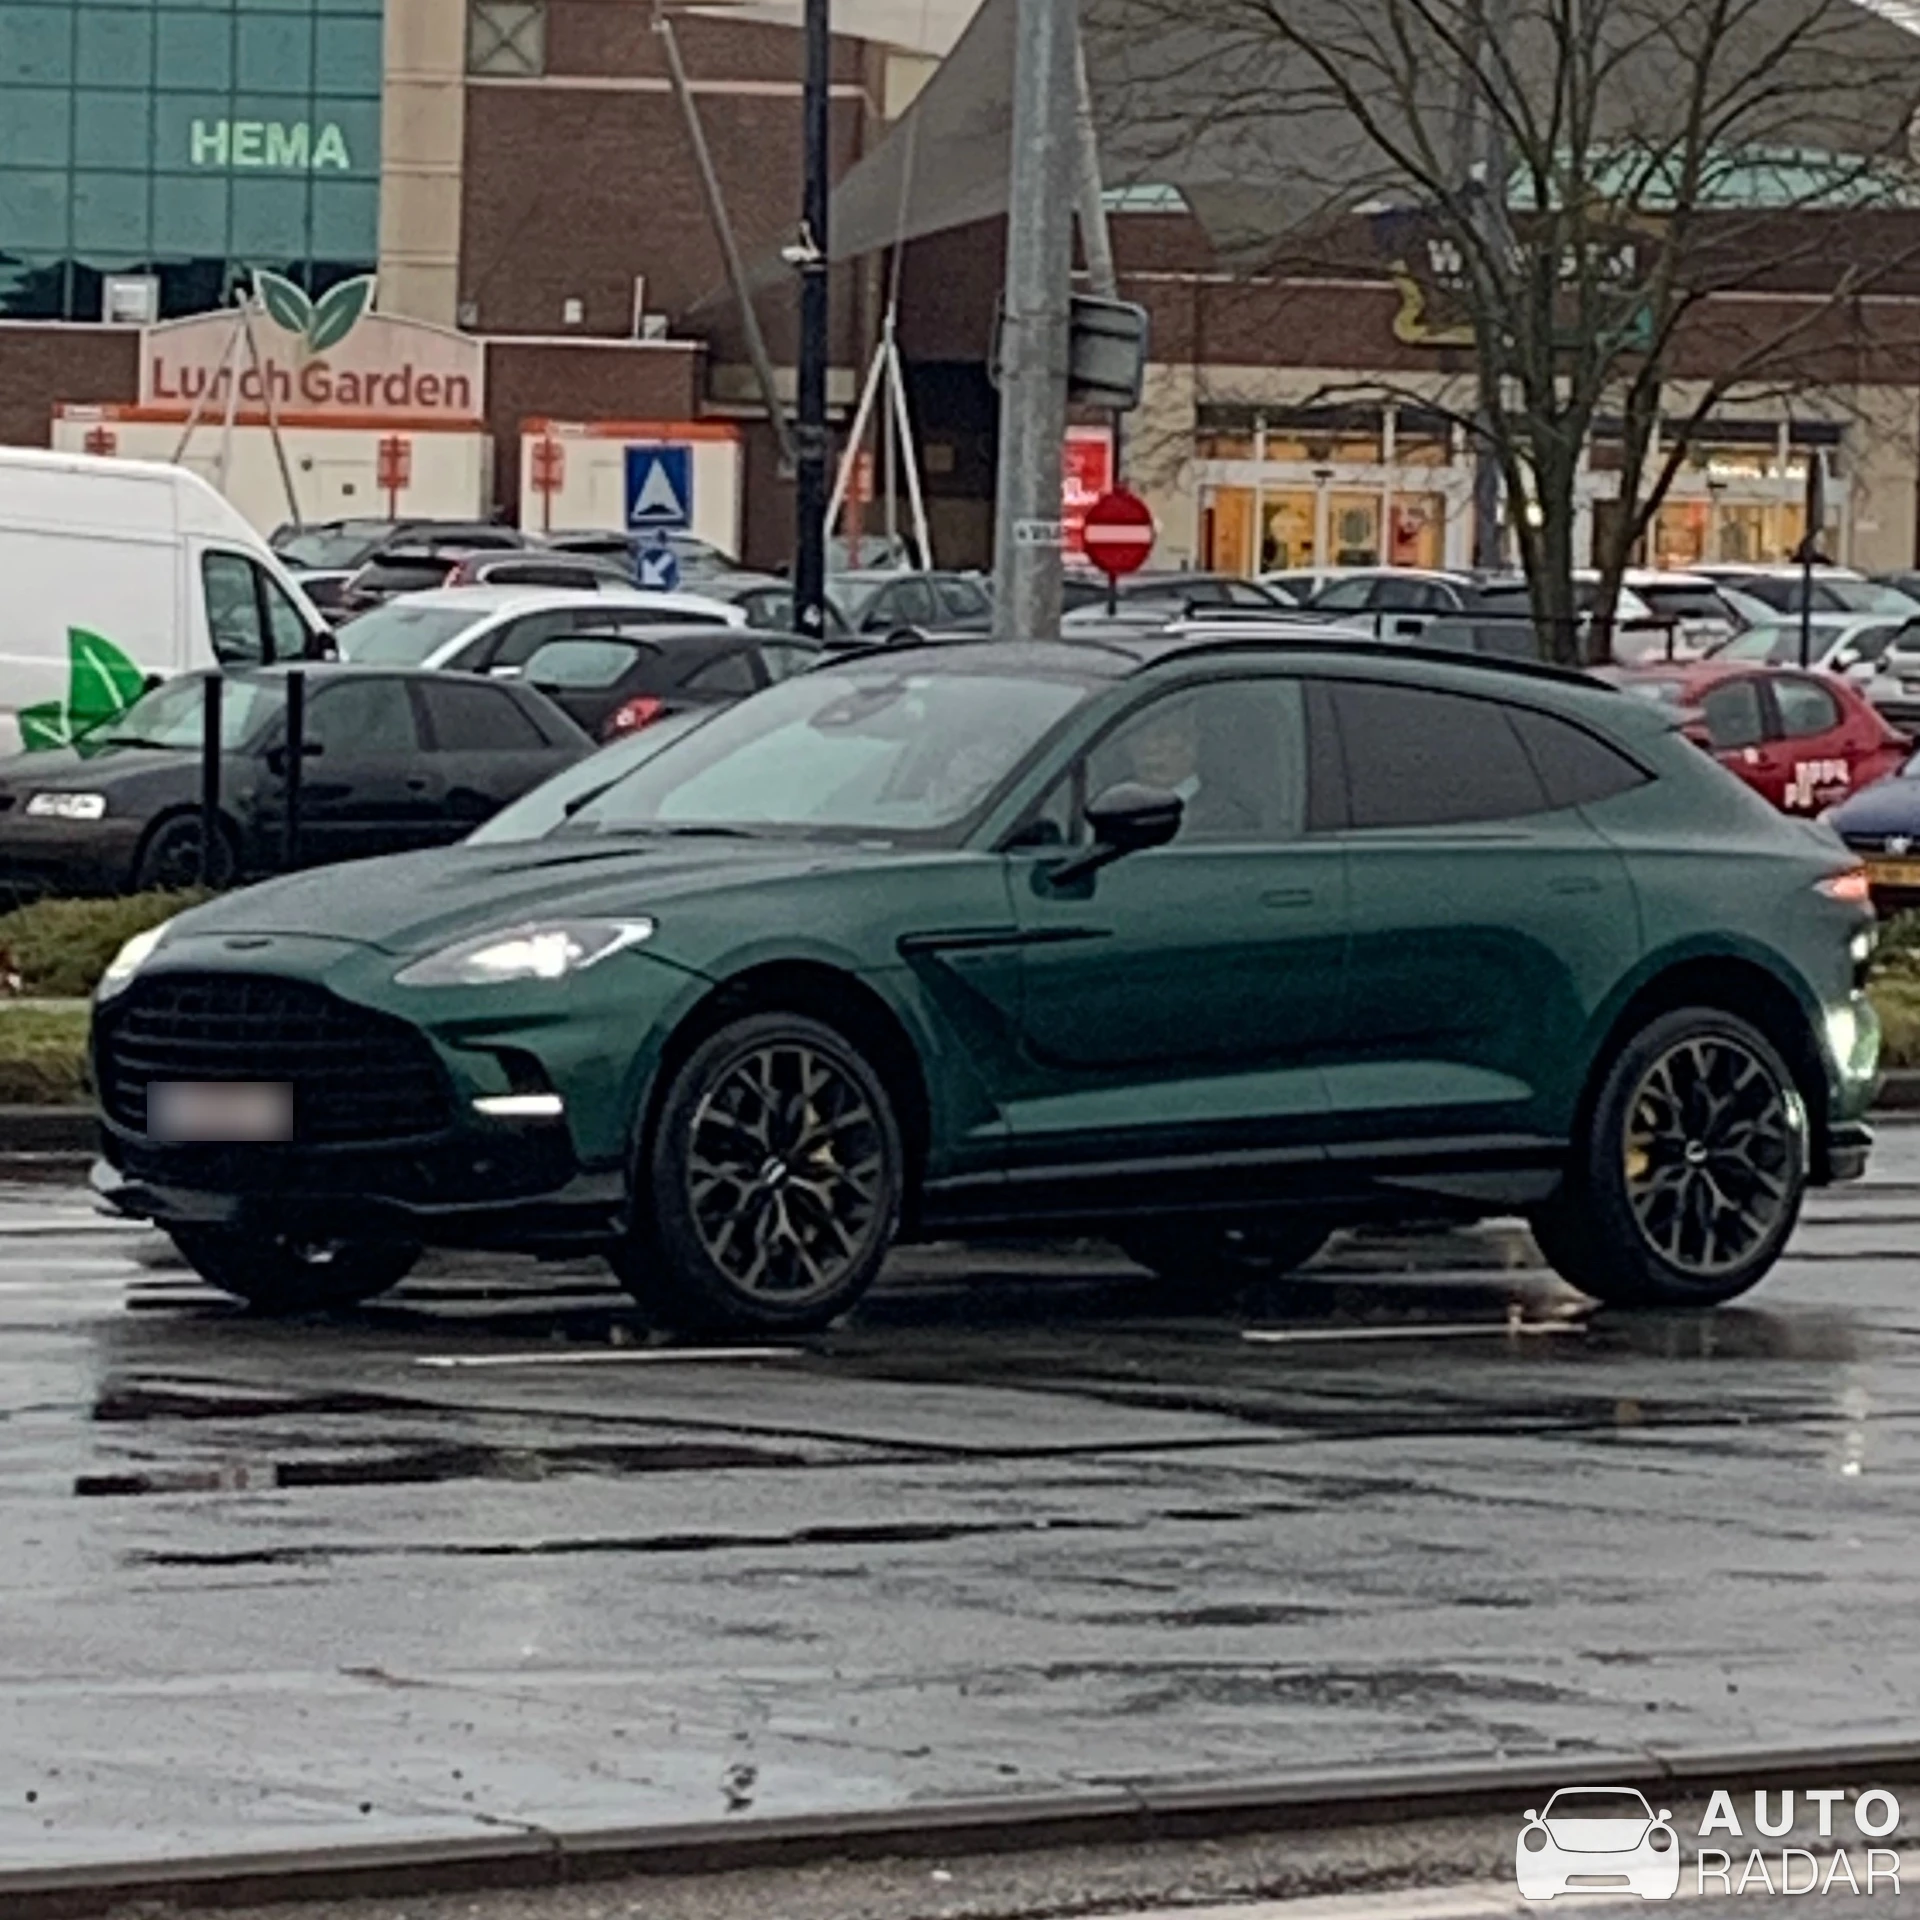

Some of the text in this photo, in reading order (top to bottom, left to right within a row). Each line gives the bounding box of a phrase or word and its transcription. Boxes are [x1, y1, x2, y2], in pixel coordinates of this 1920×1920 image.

[190, 119, 350, 169] HEMA
[152, 356, 471, 408] Lunch Garden
